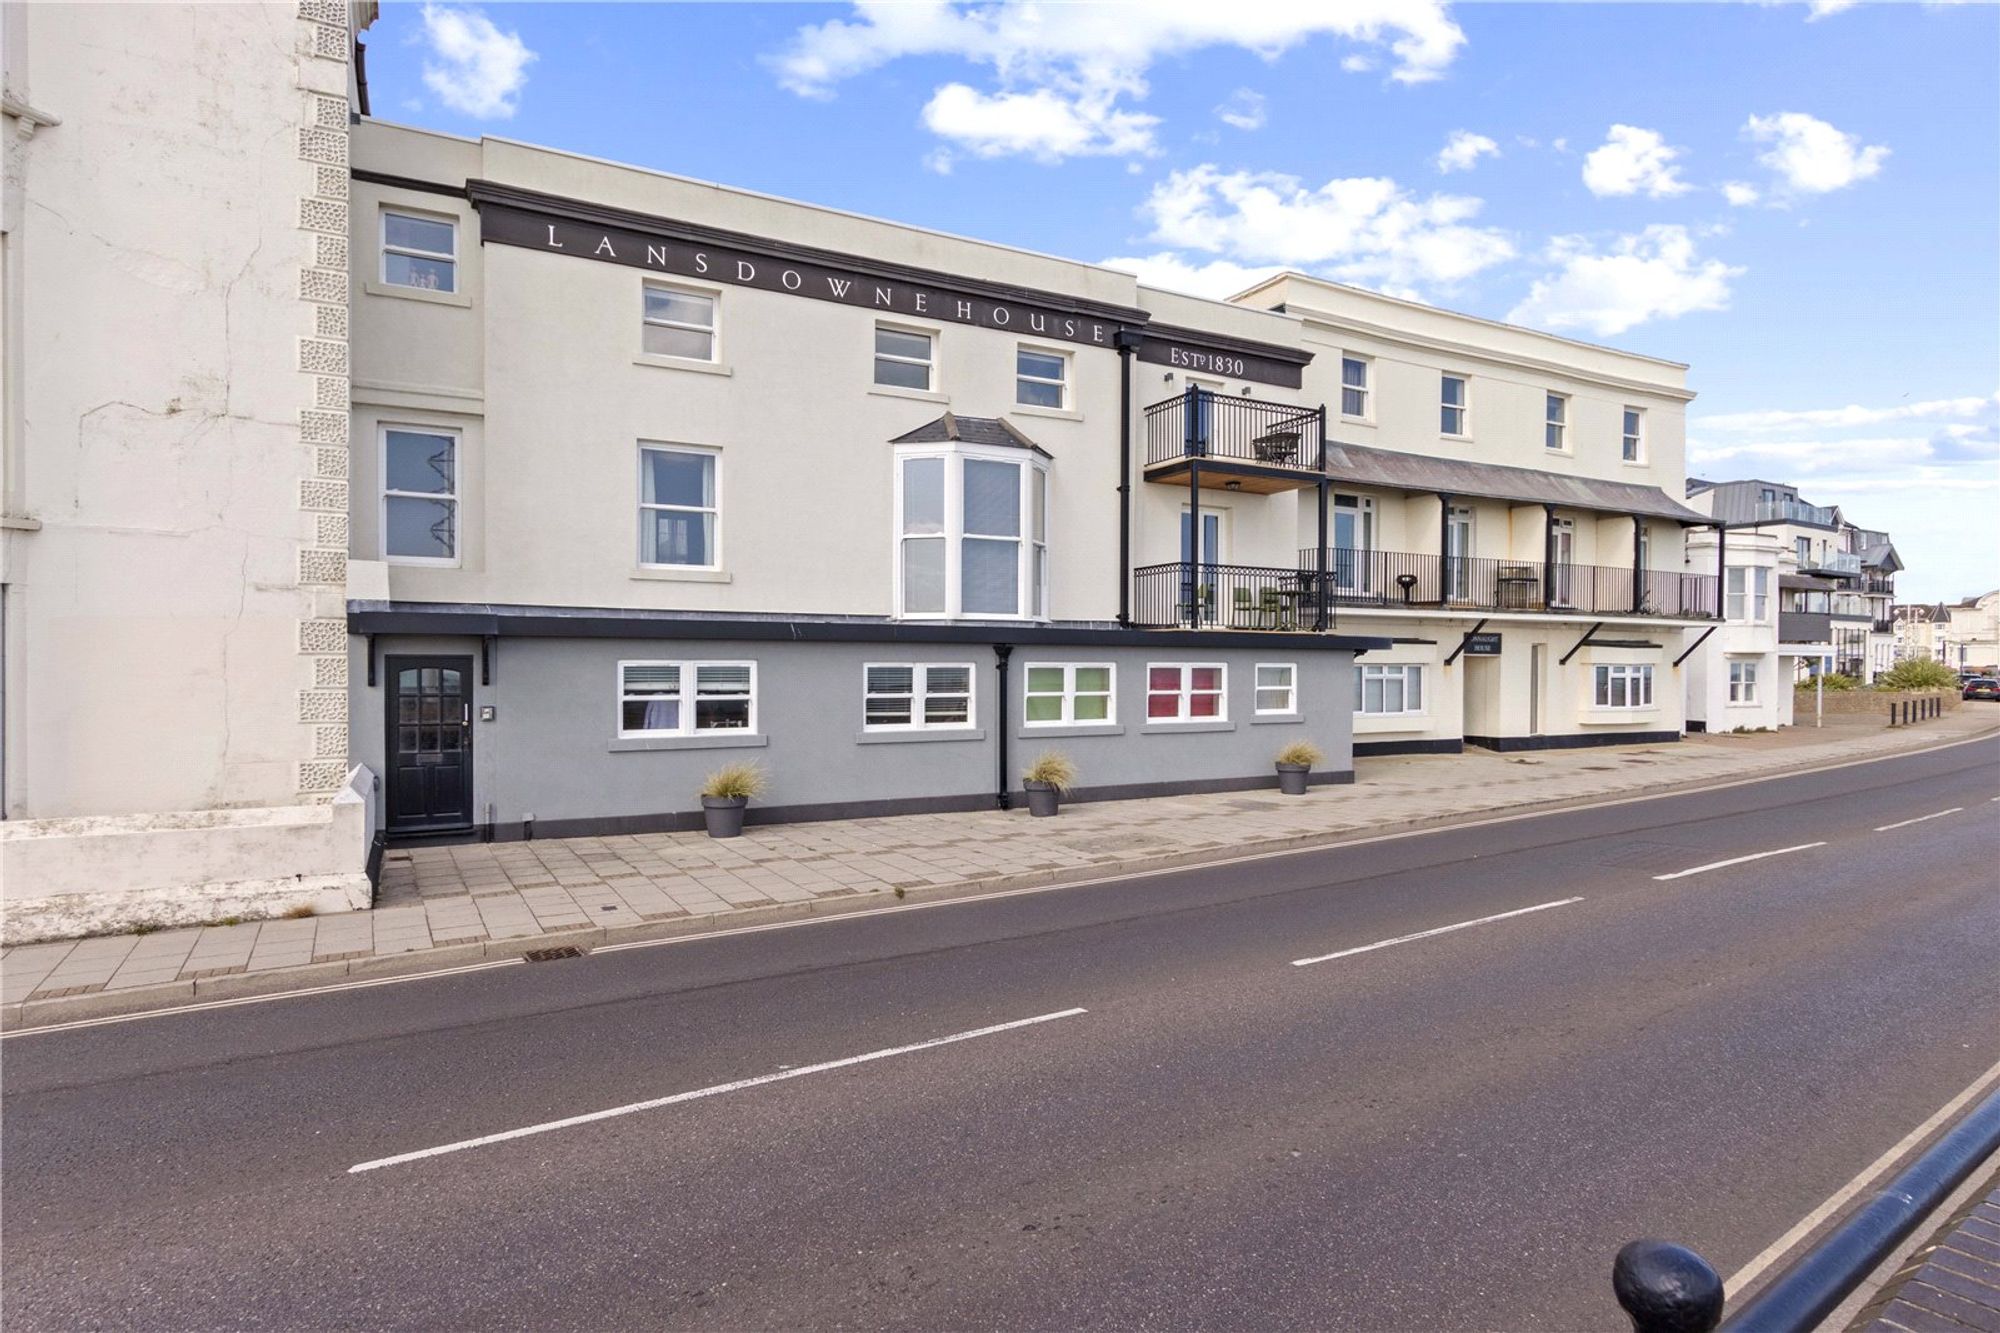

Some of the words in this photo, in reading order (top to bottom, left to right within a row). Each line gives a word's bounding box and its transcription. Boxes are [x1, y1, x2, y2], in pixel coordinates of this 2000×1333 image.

[547, 224, 928, 313] LANSDOWNE
[957, 300, 1103, 343] HOUSE
[1208, 355, 1244, 375] 1830
